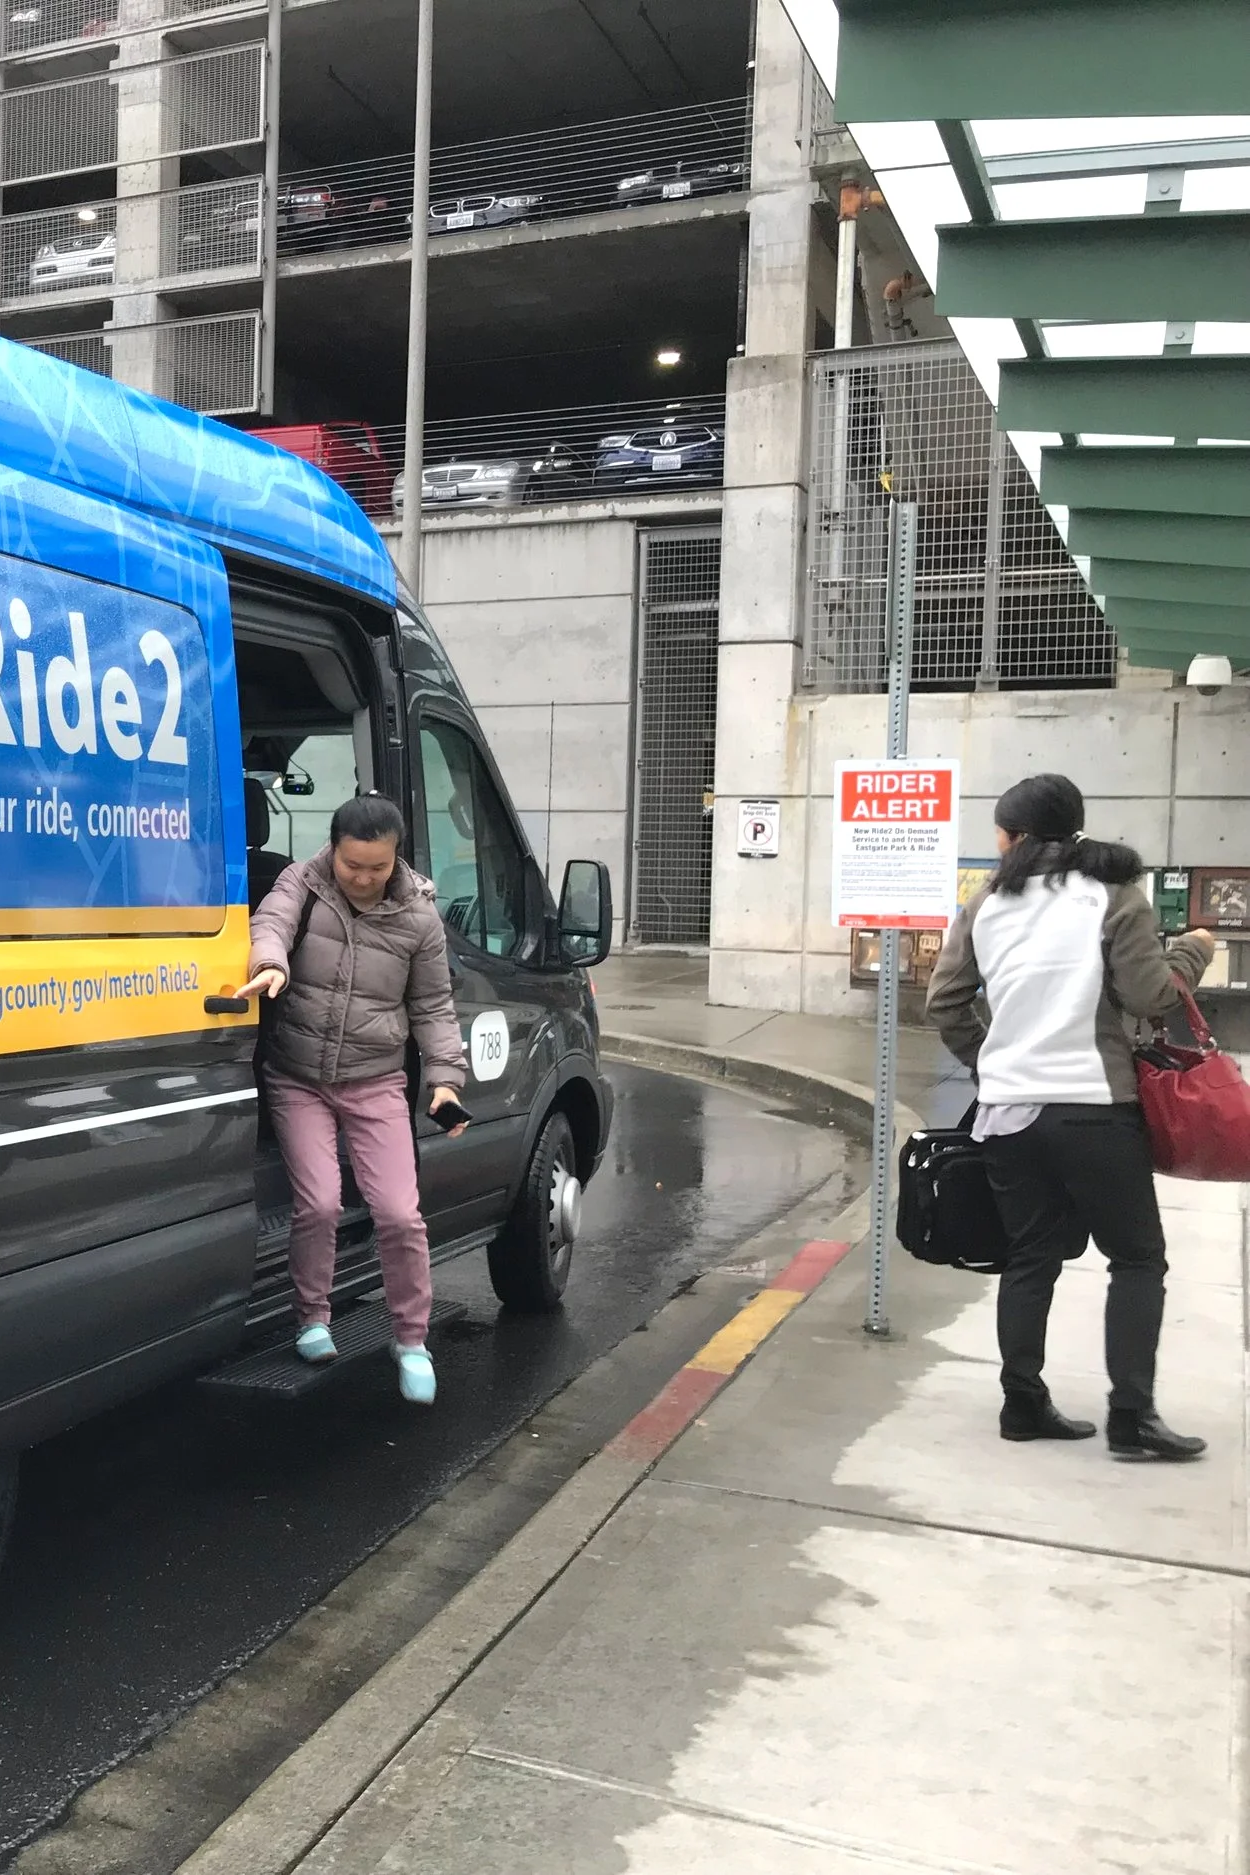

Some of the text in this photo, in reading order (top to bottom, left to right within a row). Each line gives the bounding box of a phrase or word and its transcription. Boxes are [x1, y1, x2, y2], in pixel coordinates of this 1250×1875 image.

[856, 774, 936, 793] RIDER
[25, 787, 79, 842] ride,
[87, 798, 191, 841] connected
[852, 799, 939, 818] ALERT
[753, 823, 765, 840] P
[855, 844, 888, 852] Eastgate
[479, 1031, 502, 1061] 788
